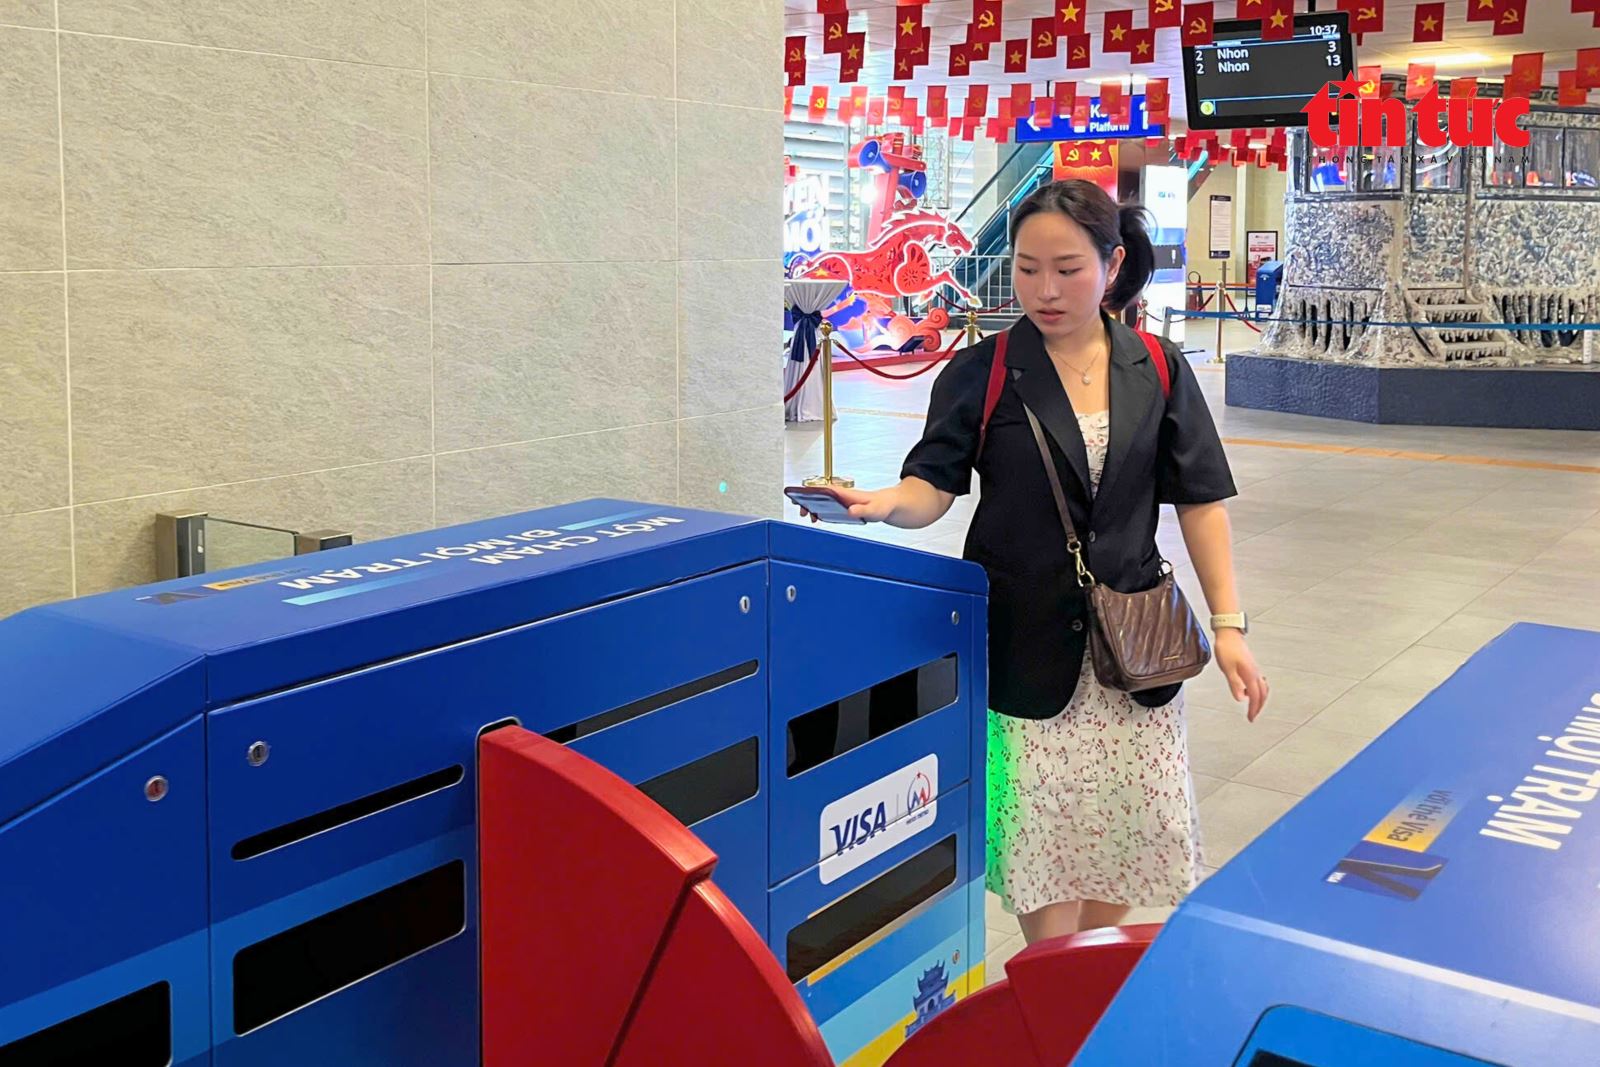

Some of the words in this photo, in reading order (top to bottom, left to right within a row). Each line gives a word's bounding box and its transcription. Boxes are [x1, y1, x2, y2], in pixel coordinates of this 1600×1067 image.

[1310, 24, 1338, 36] 10:37
[1195, 51, 1204, 61] 2
[1217, 48, 1249, 60] Nhon
[1328, 41, 1337, 53] 3
[1196, 63, 1205, 74] 2
[1218, 61, 1250, 73] Nhon
[1326, 54, 1342, 67] 13
[596, 516, 685, 538] MỘT
[469, 535, 599, 565] CHẠM
[278, 557, 433, 590] TRẠM
[829, 801, 887, 856] VISA
[1387, 821, 1429, 842] Visa
